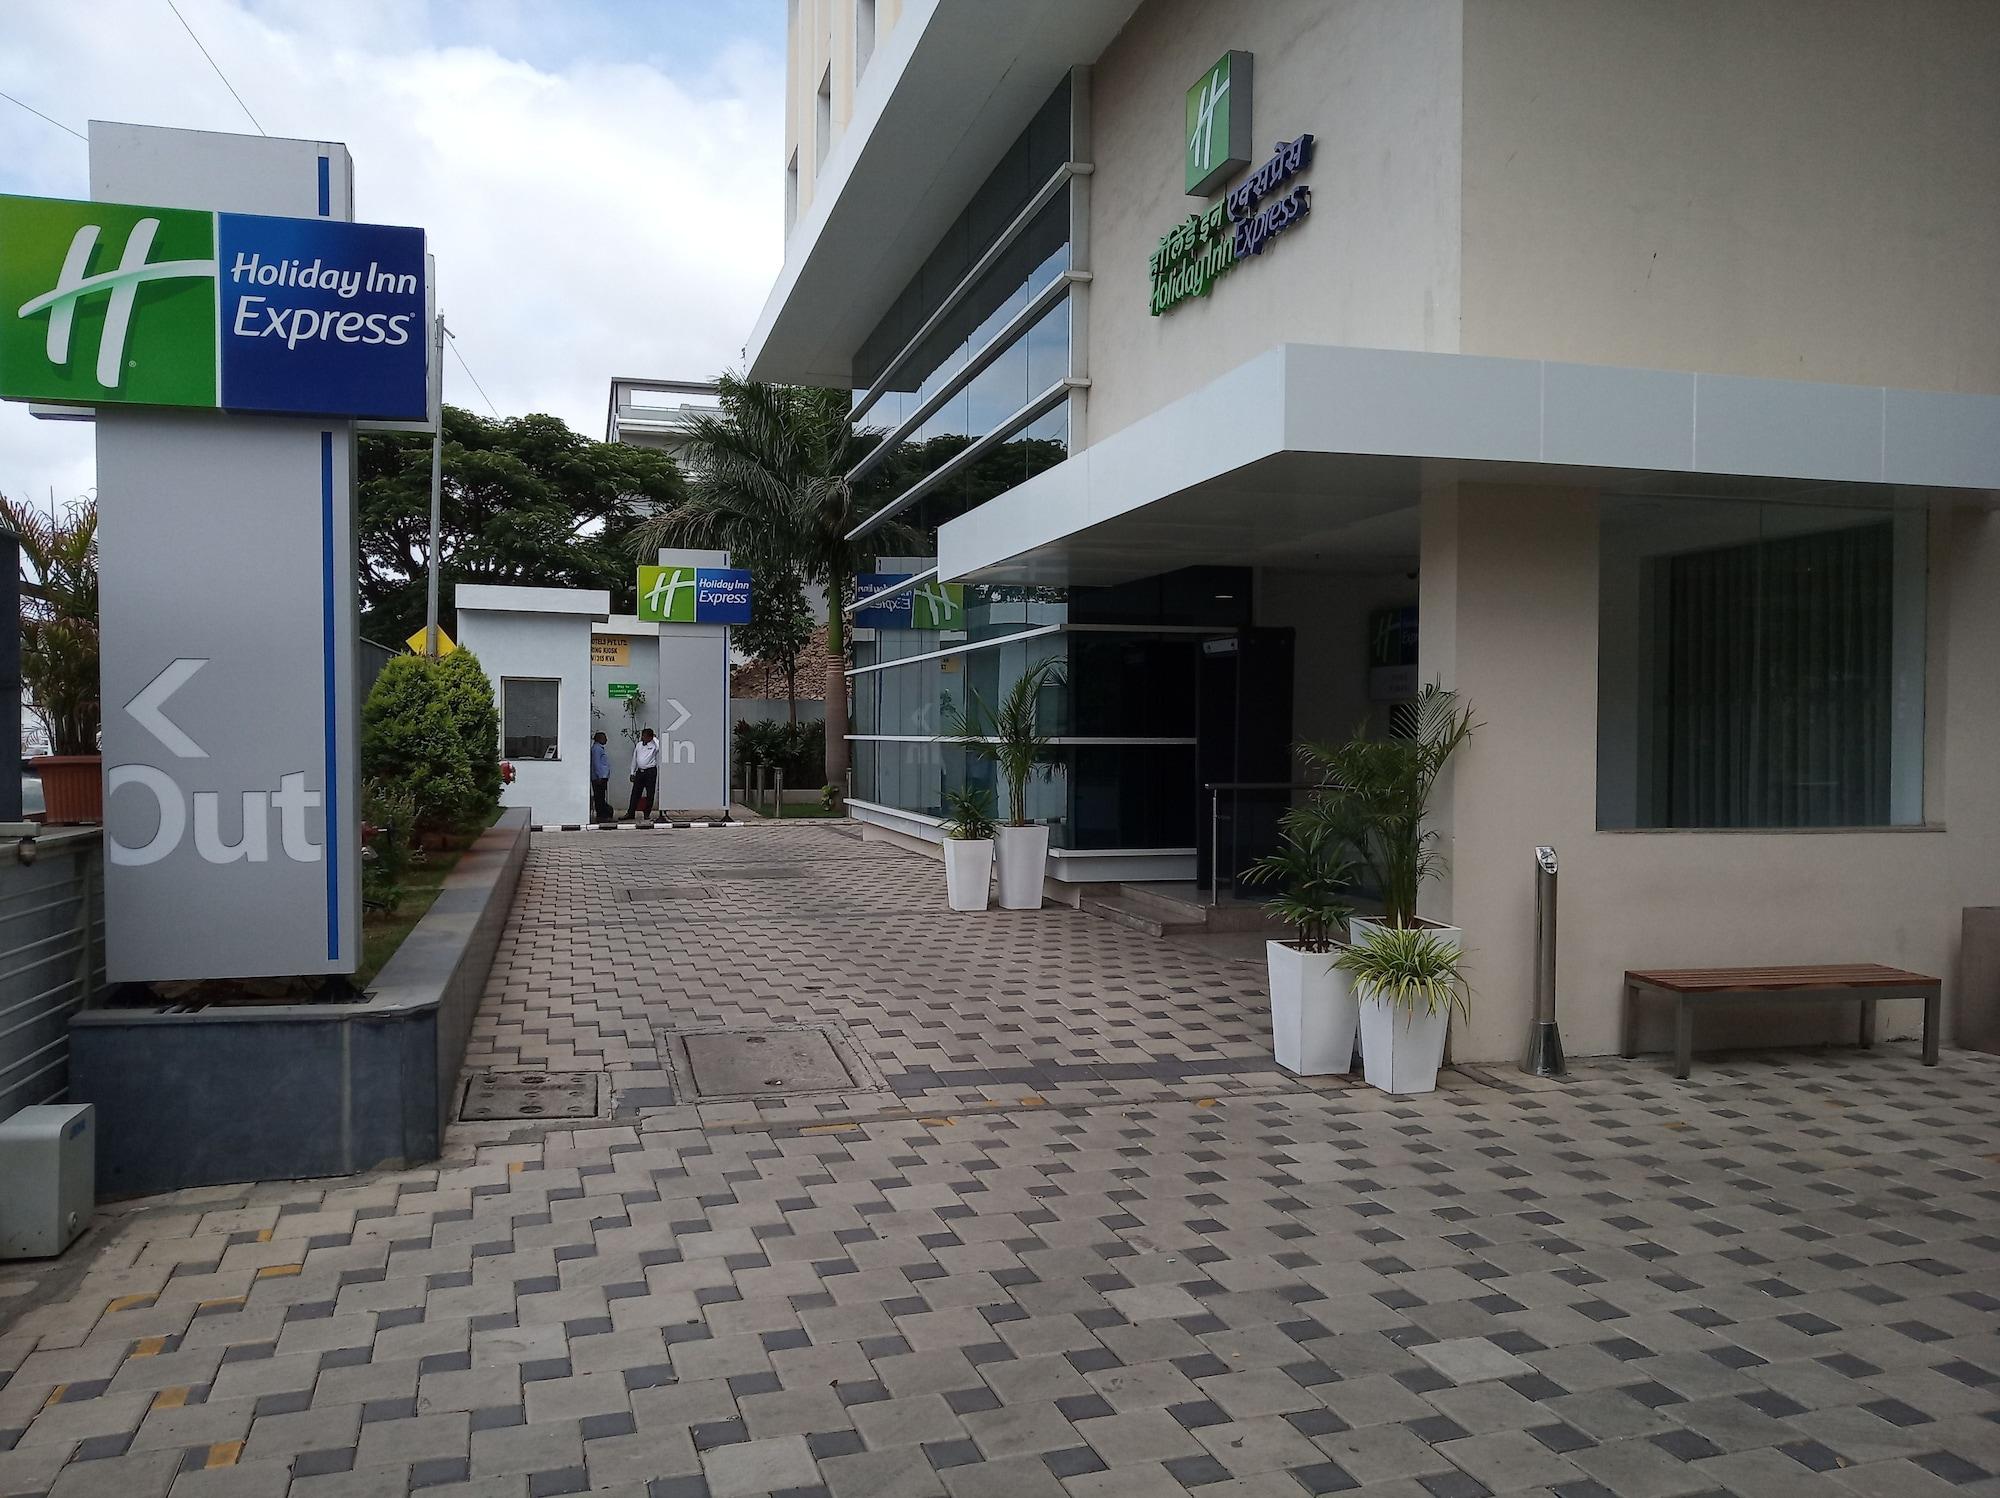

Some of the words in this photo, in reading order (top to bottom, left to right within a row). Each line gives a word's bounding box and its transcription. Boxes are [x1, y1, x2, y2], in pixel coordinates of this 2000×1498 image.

[1151, 256, 1206, 316] Holiday
[1207, 237, 1235, 279] Inn
[1235, 186, 1309, 258] Express
[230, 252, 362, 297] Holiday
[366, 262, 417, 295] Inn
[233, 296, 412, 350] Express
[699, 578, 735, 592] Holiday
[735, 579, 749, 590] Inn
[699, 590, 747, 606] Express
[661, 732, 695, 764] In
[108, 763, 324, 867] Out
